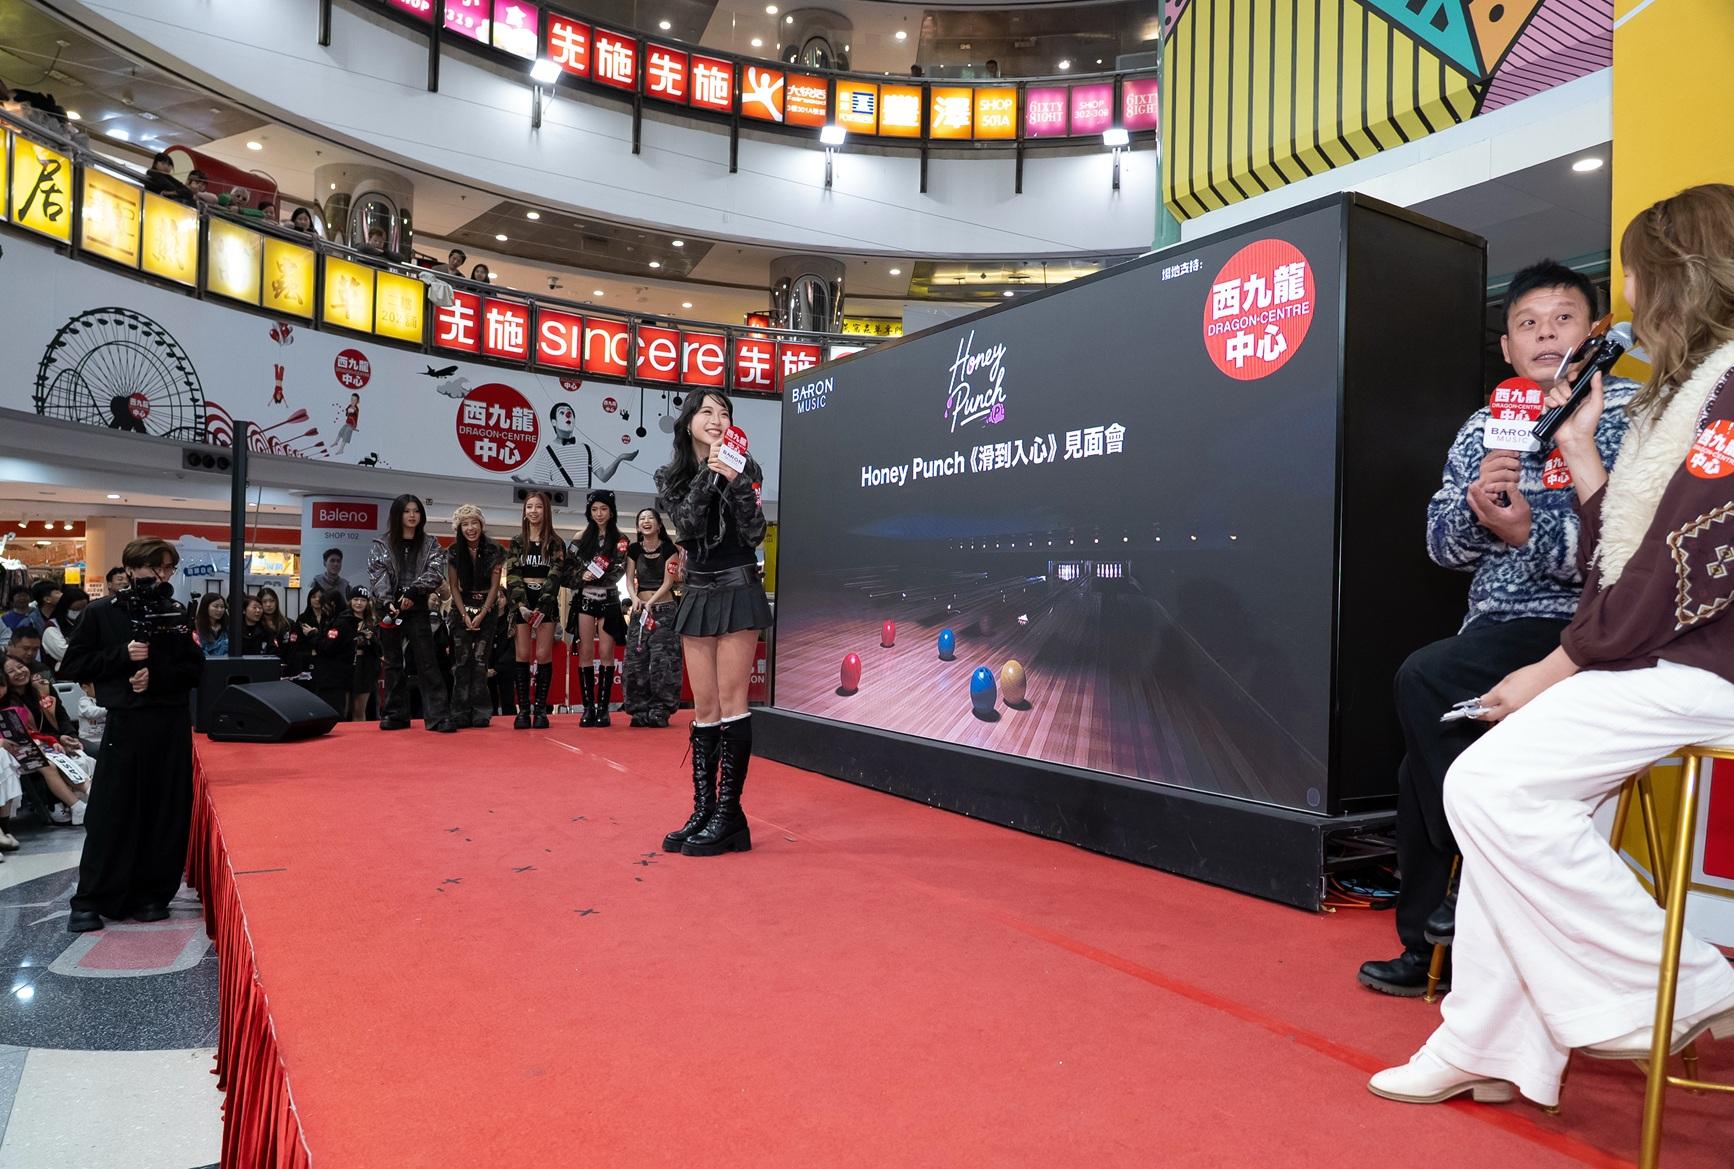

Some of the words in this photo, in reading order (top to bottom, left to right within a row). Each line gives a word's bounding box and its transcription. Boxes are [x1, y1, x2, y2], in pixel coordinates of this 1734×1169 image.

[551, 22, 633, 84] 先施
[649, 52, 729, 106] 先施
[979, 98, 1013, 111] SHOP
[1078, 99, 1104, 110] SHOP
[1212, 261, 1306, 320] 西九龍
[439, 299, 524, 353] 先施
[541, 320, 725, 376] sincere
[1225, 323, 1288, 369] 中心
[949, 329, 1007, 394] Honey
[342, 373, 363, 387] 中心
[792, 377, 833, 403] BARON
[797, 395, 826, 415] MUSIC
[948, 366, 1007, 433] Punch
[1494, 387, 1542, 404] 西九龍
[463, 399, 534, 432] 西九龍
[1496, 435, 1528, 444] MUSIC
[474, 438, 521, 465] 中心
[861, 464, 909, 487] Honey
[912, 451, 965, 480] Punch
[1063, 422, 1126, 461] 見面會
[1544, 457, 1566, 473] 西九
[1690, 453, 1721, 475] 中心
[1547, 470, 1570, 485] 中心
[319, 507, 368, 522] Baleno
[324, 531, 346, 540] SHOP
